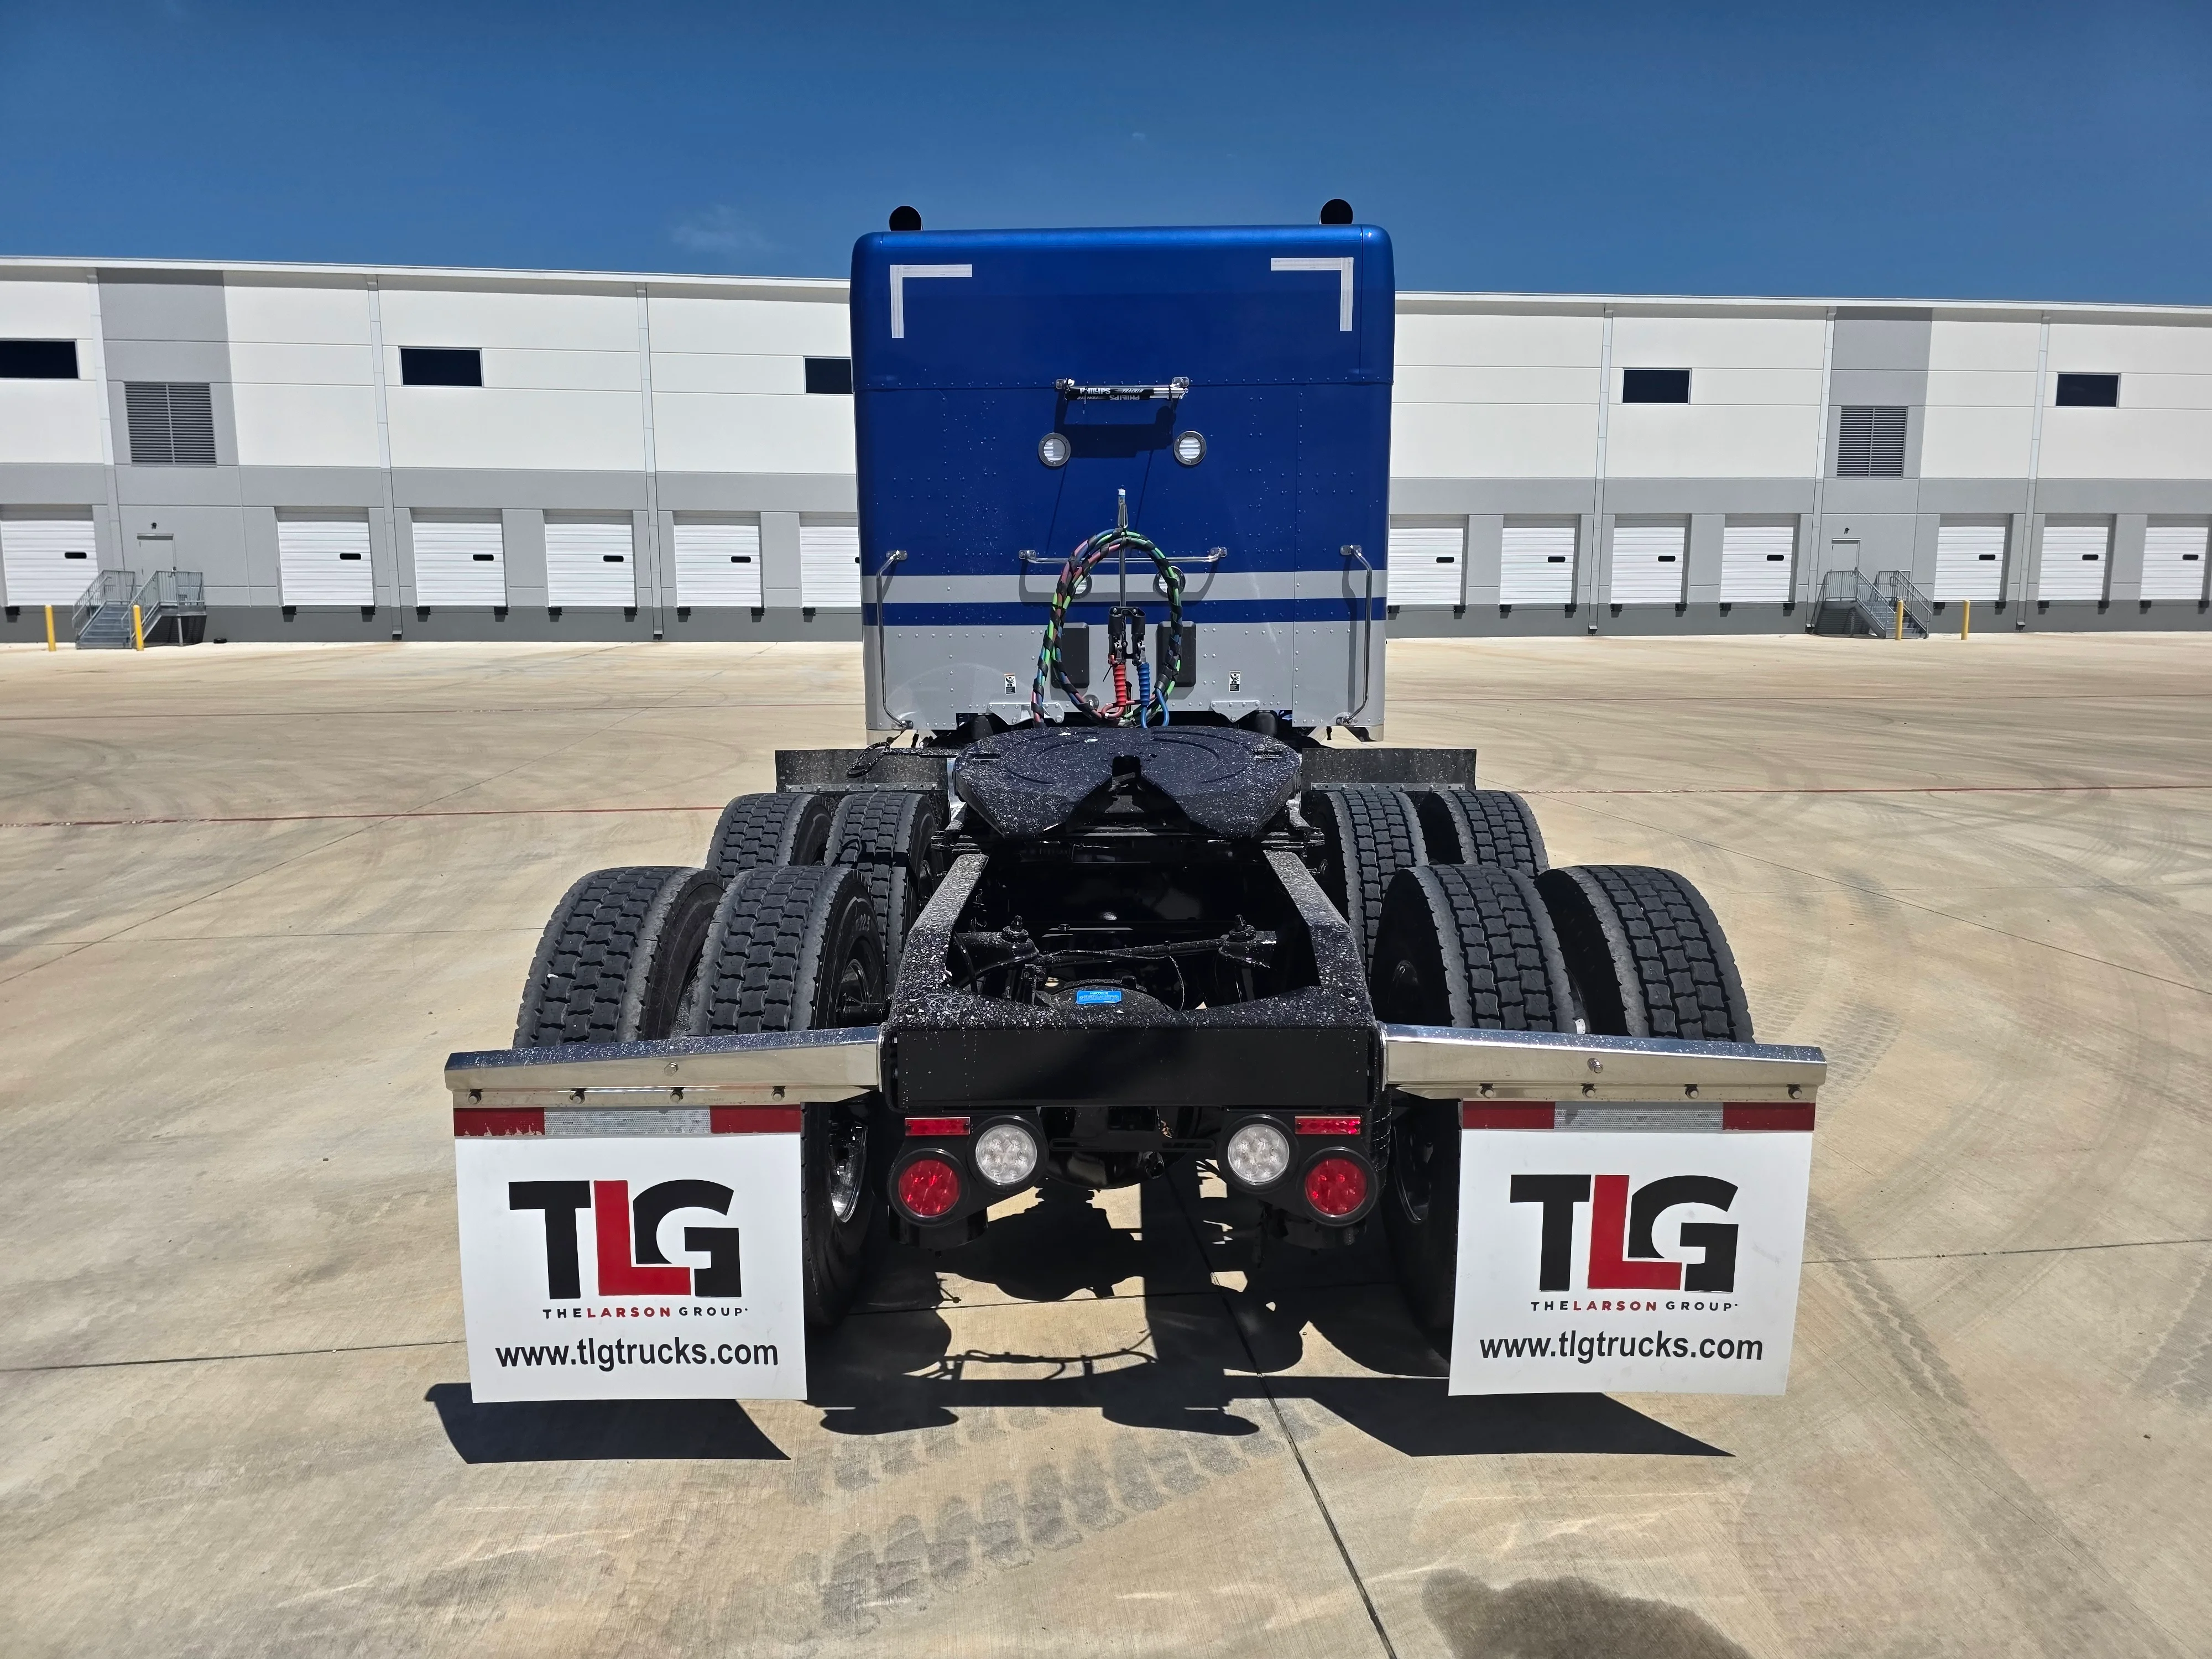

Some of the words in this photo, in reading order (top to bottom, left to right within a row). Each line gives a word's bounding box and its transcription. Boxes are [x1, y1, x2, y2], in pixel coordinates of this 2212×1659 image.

[508, 1179, 742, 1299] TLG
[1510, 1174, 1739, 1292] TLG
[679, 1307, 742, 1317] GROUP
[1666, 1301, 1732, 1311] GROUP
[495, 1337, 778, 1372] www.tlgtrucks.com
[1479, 1330, 1763, 1364] www.tlgtrucks.com
